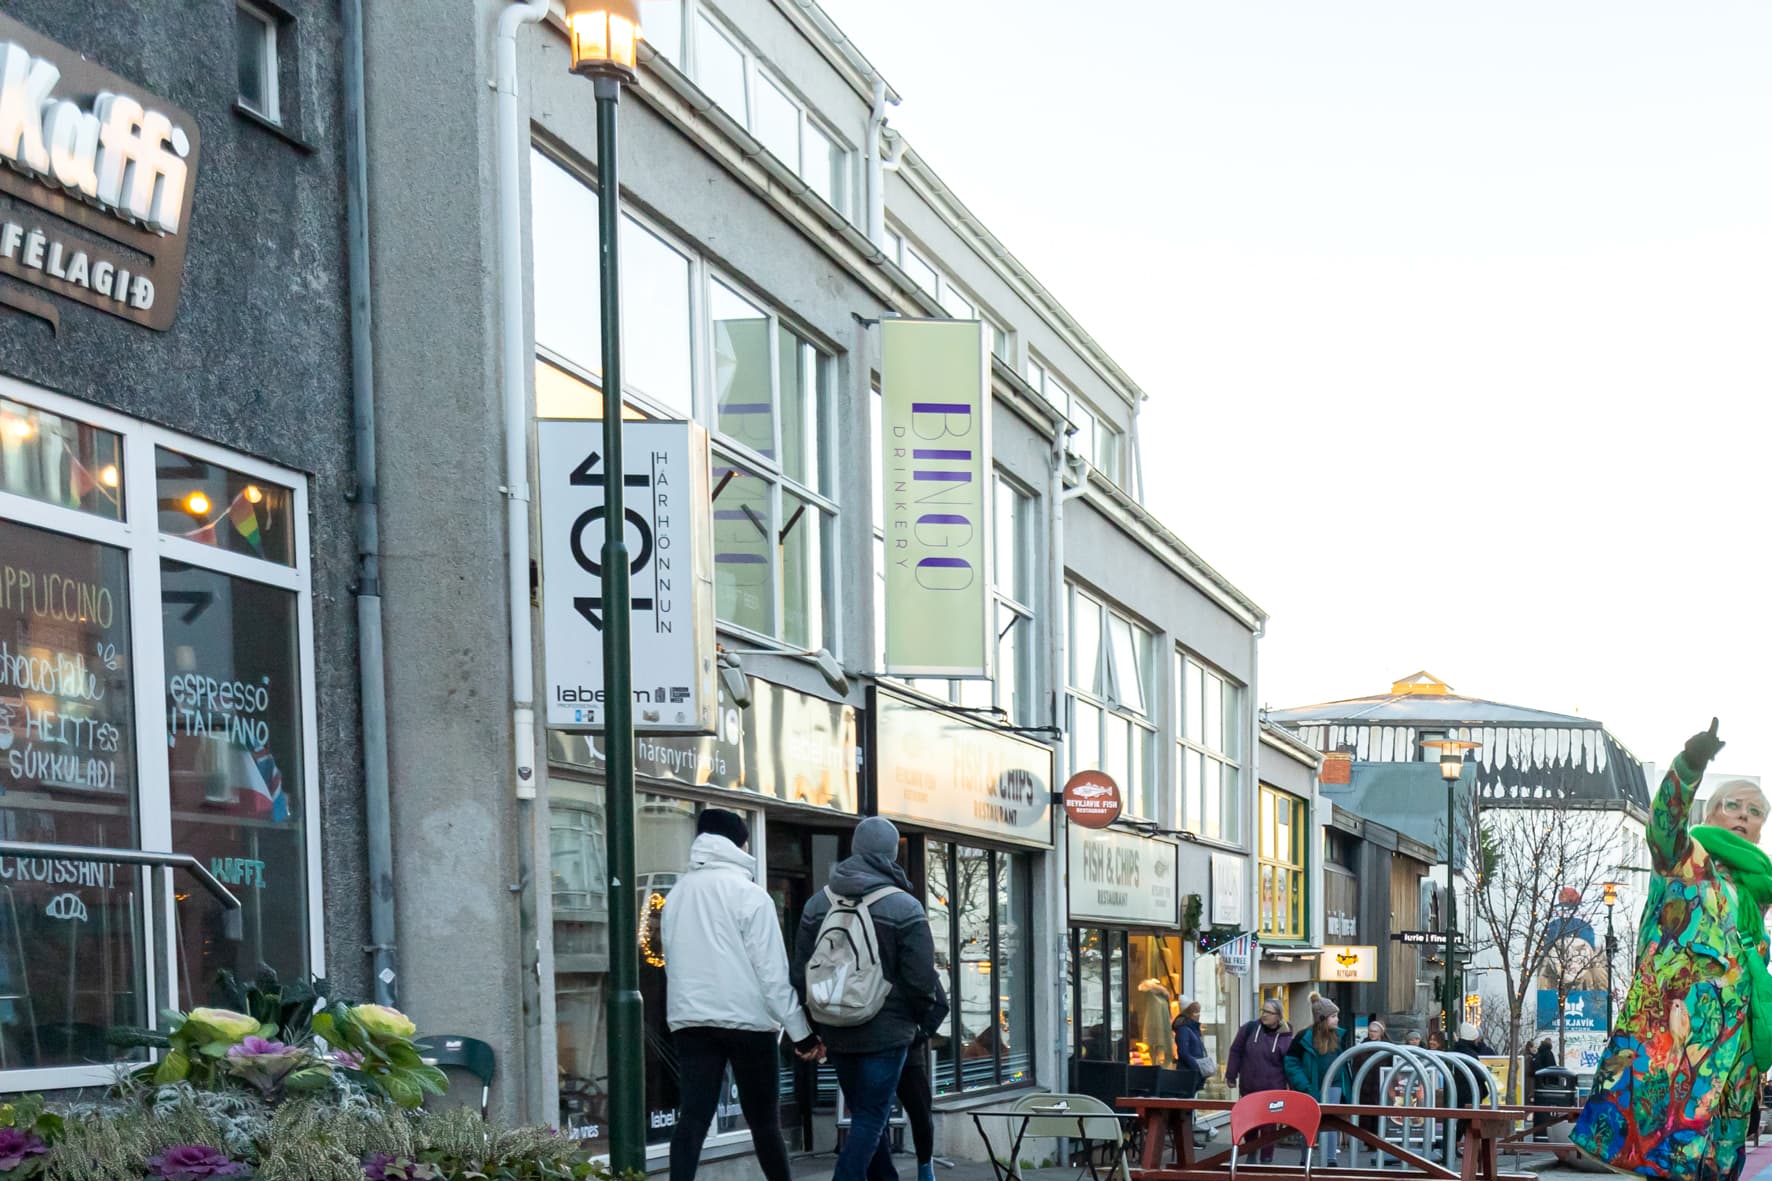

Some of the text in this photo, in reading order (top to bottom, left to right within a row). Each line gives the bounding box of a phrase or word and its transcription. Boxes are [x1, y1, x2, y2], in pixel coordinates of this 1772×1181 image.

[0, 42, 190, 237] Kaffi
[1, 221, 155, 310] FÉLAGIÐ
[893, 426, 908, 568] DRINKERY
[912, 403, 974, 590] BINGO
[656, 450, 672, 633] HÁRHÖNNUN
[0, 565, 113, 628] PPUCCINO
[171, 706, 269, 745] ITALIANO
[557, 685, 650, 703] labem
[26, 706, 98, 750] HEITT
[1083, 840, 1139, 888] FISH & CHIPS
[1552, 1018, 1595, 1028] REKJAVÍK
